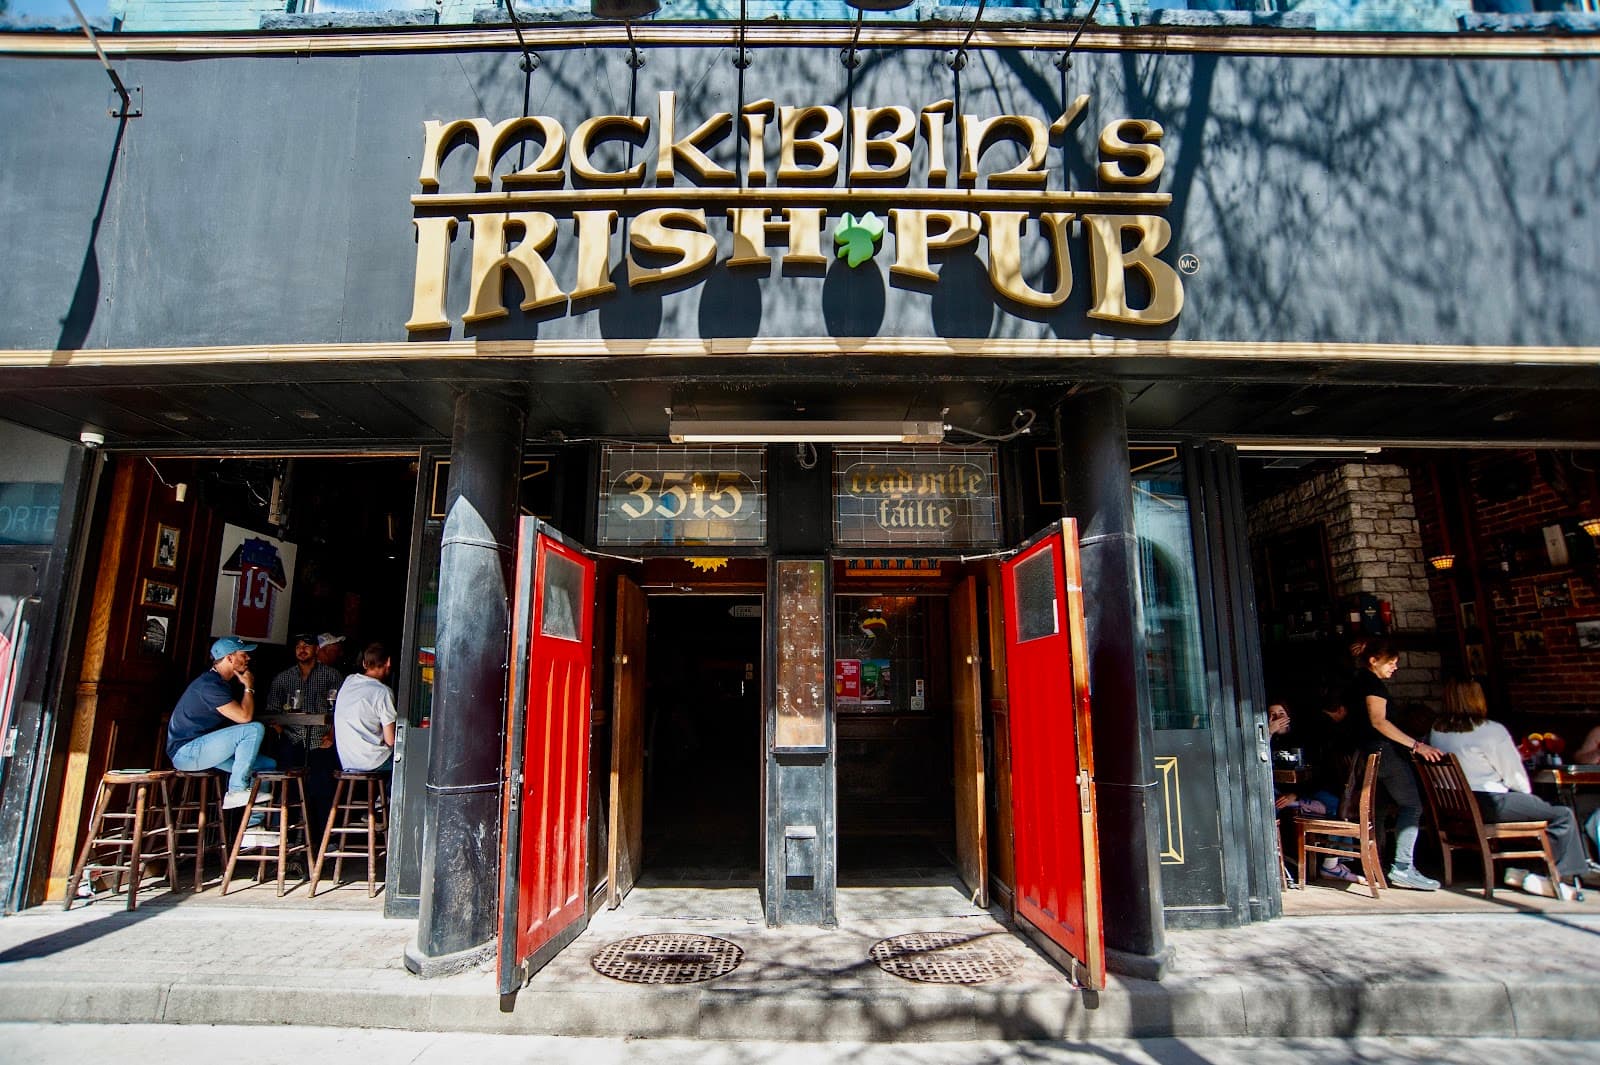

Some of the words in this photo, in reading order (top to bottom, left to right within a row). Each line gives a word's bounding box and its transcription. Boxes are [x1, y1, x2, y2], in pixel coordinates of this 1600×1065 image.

[405, 207, 828, 332] IRISH
[888, 208, 1185, 326] PUB
[620, 471, 743, 518] 3515
[242, 568, 271, 609] 13
